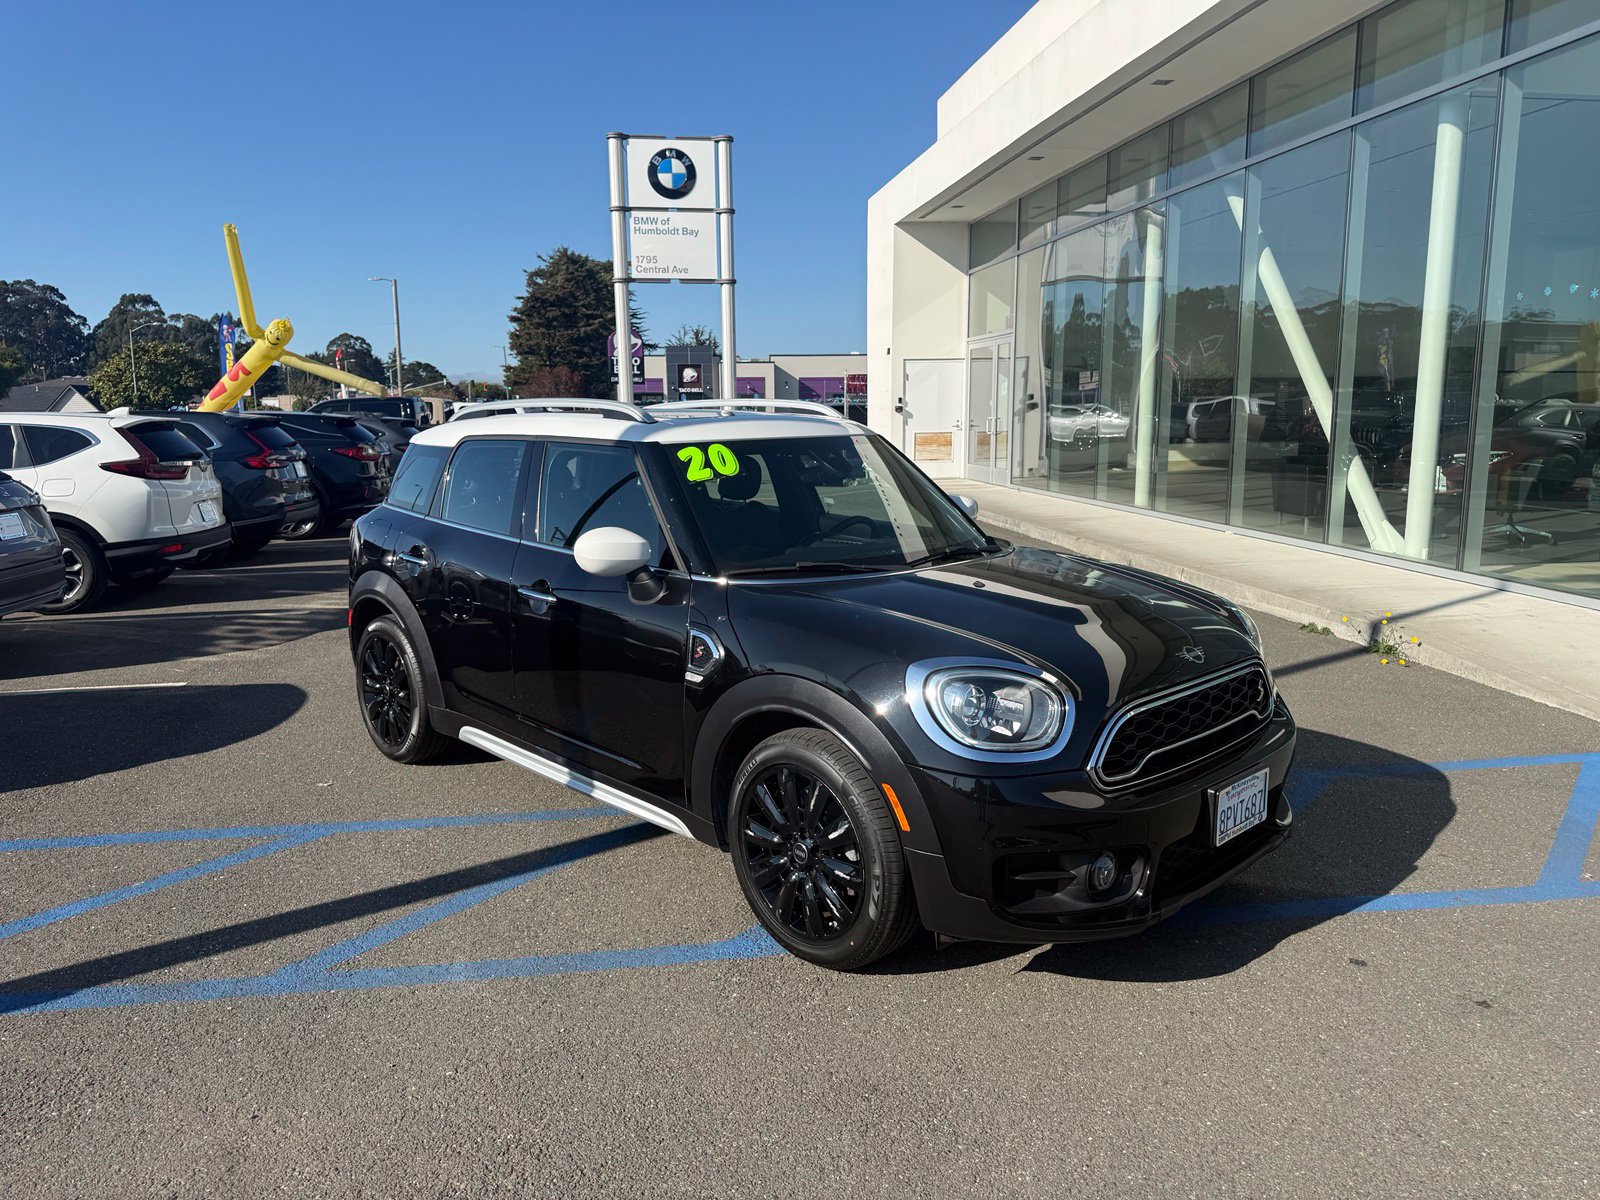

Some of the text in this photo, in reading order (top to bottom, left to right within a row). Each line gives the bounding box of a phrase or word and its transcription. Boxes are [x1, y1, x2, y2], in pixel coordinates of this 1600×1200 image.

[633, 216, 671, 226] BMW of
[633, 226, 700, 238] Humboldt Bay
[635, 255, 658, 264] 1795
[635, 264, 689, 274] Central Ave
[611, 356, 641, 366] TO
[613, 365, 641, 374] BL
[676, 443, 740, 482] 20
[1219, 789, 1264, 834] 8PVT687
